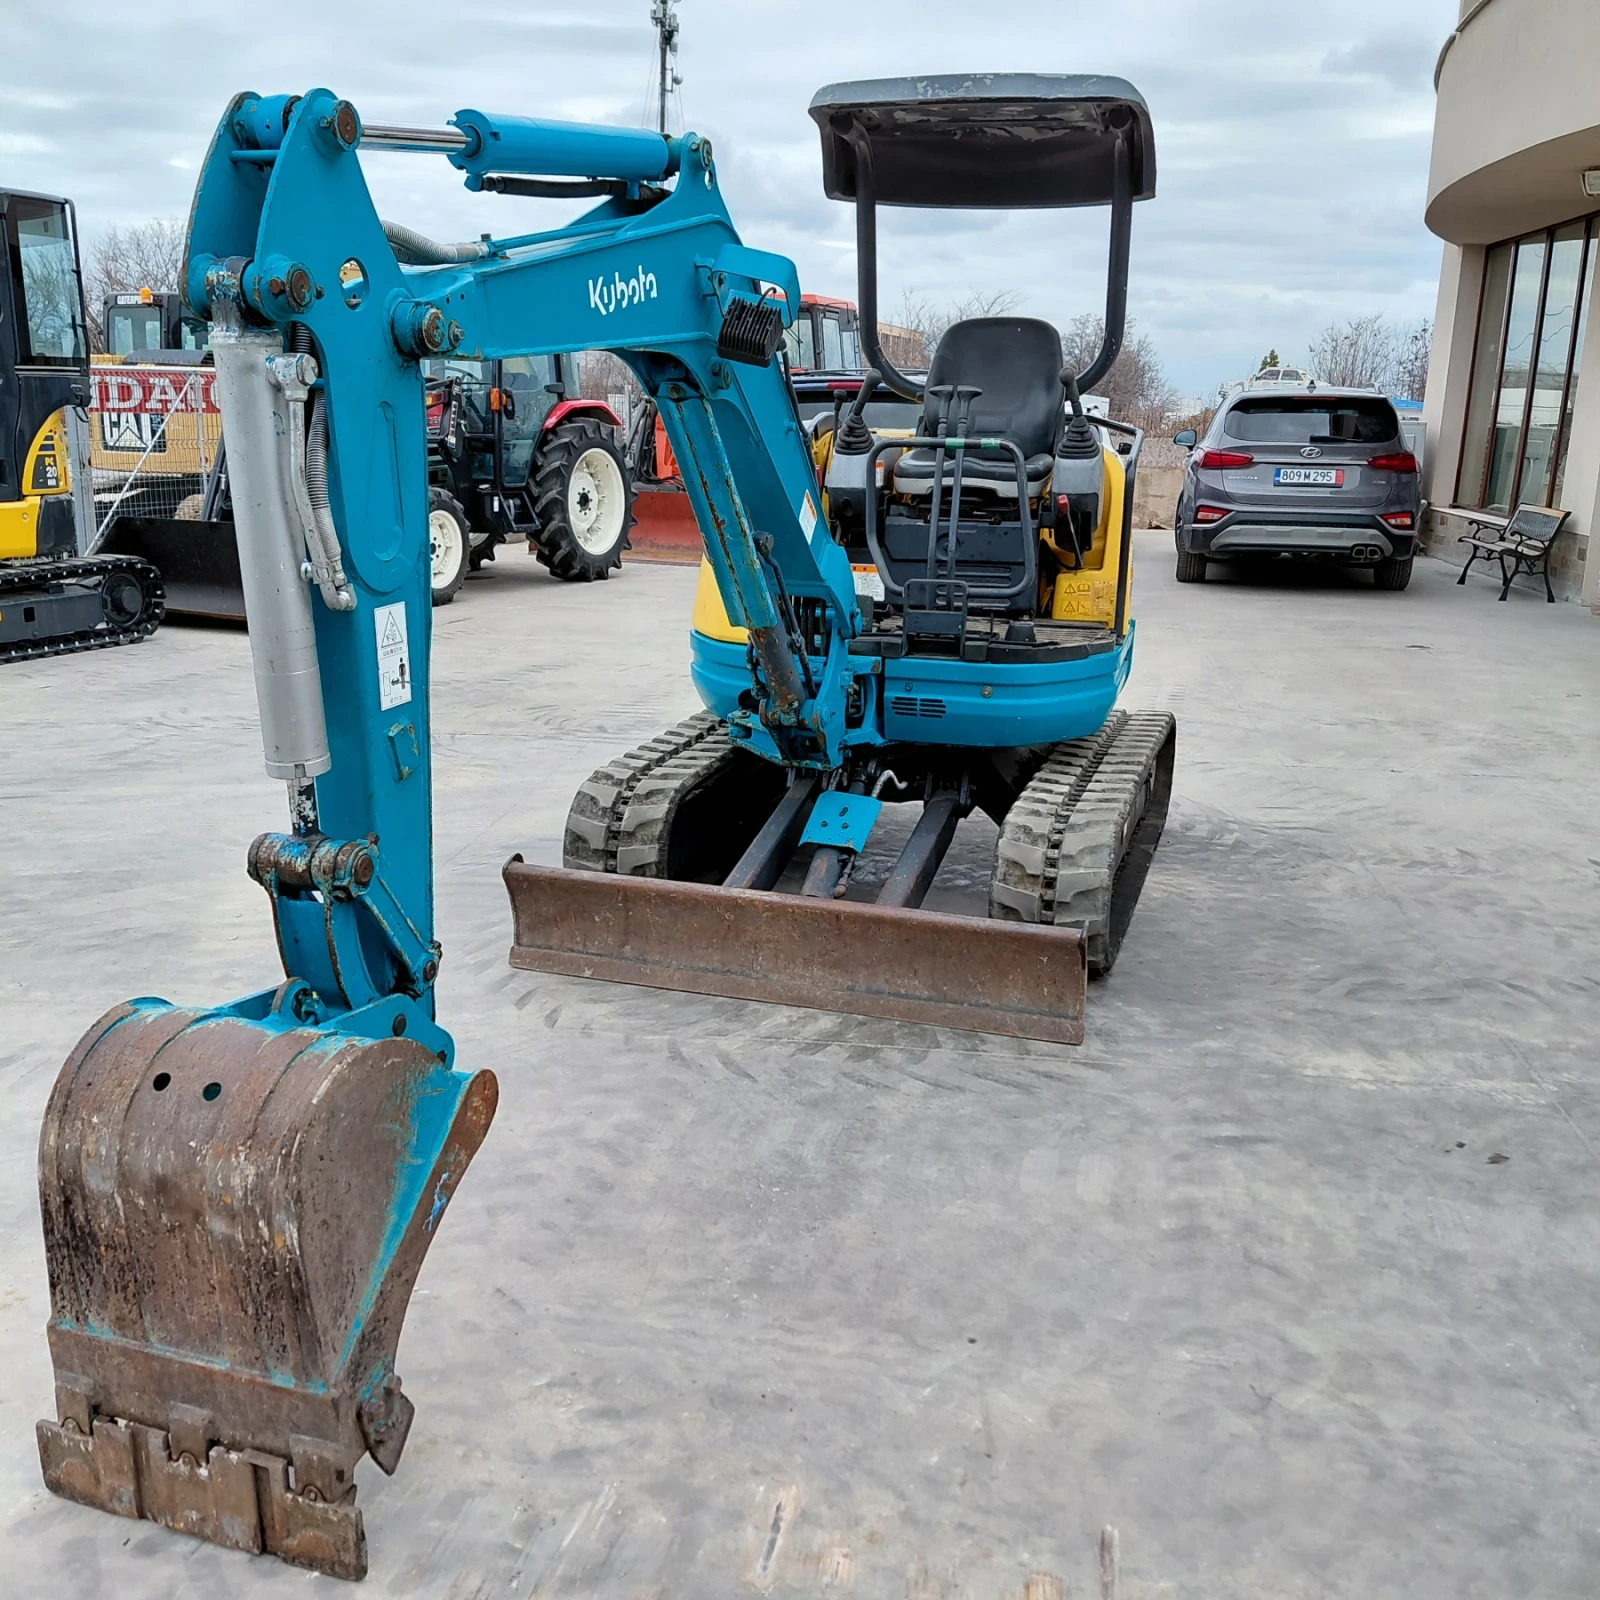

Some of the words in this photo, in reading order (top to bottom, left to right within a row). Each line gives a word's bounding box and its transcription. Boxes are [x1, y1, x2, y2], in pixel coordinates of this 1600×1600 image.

[588, 265, 658, 315] Kubota
[46, 466, 57, 478] 20
[1282, 471, 1301, 481] 809
[1304, 471, 1311, 481] M
[1313, 471, 1333, 482] 295
